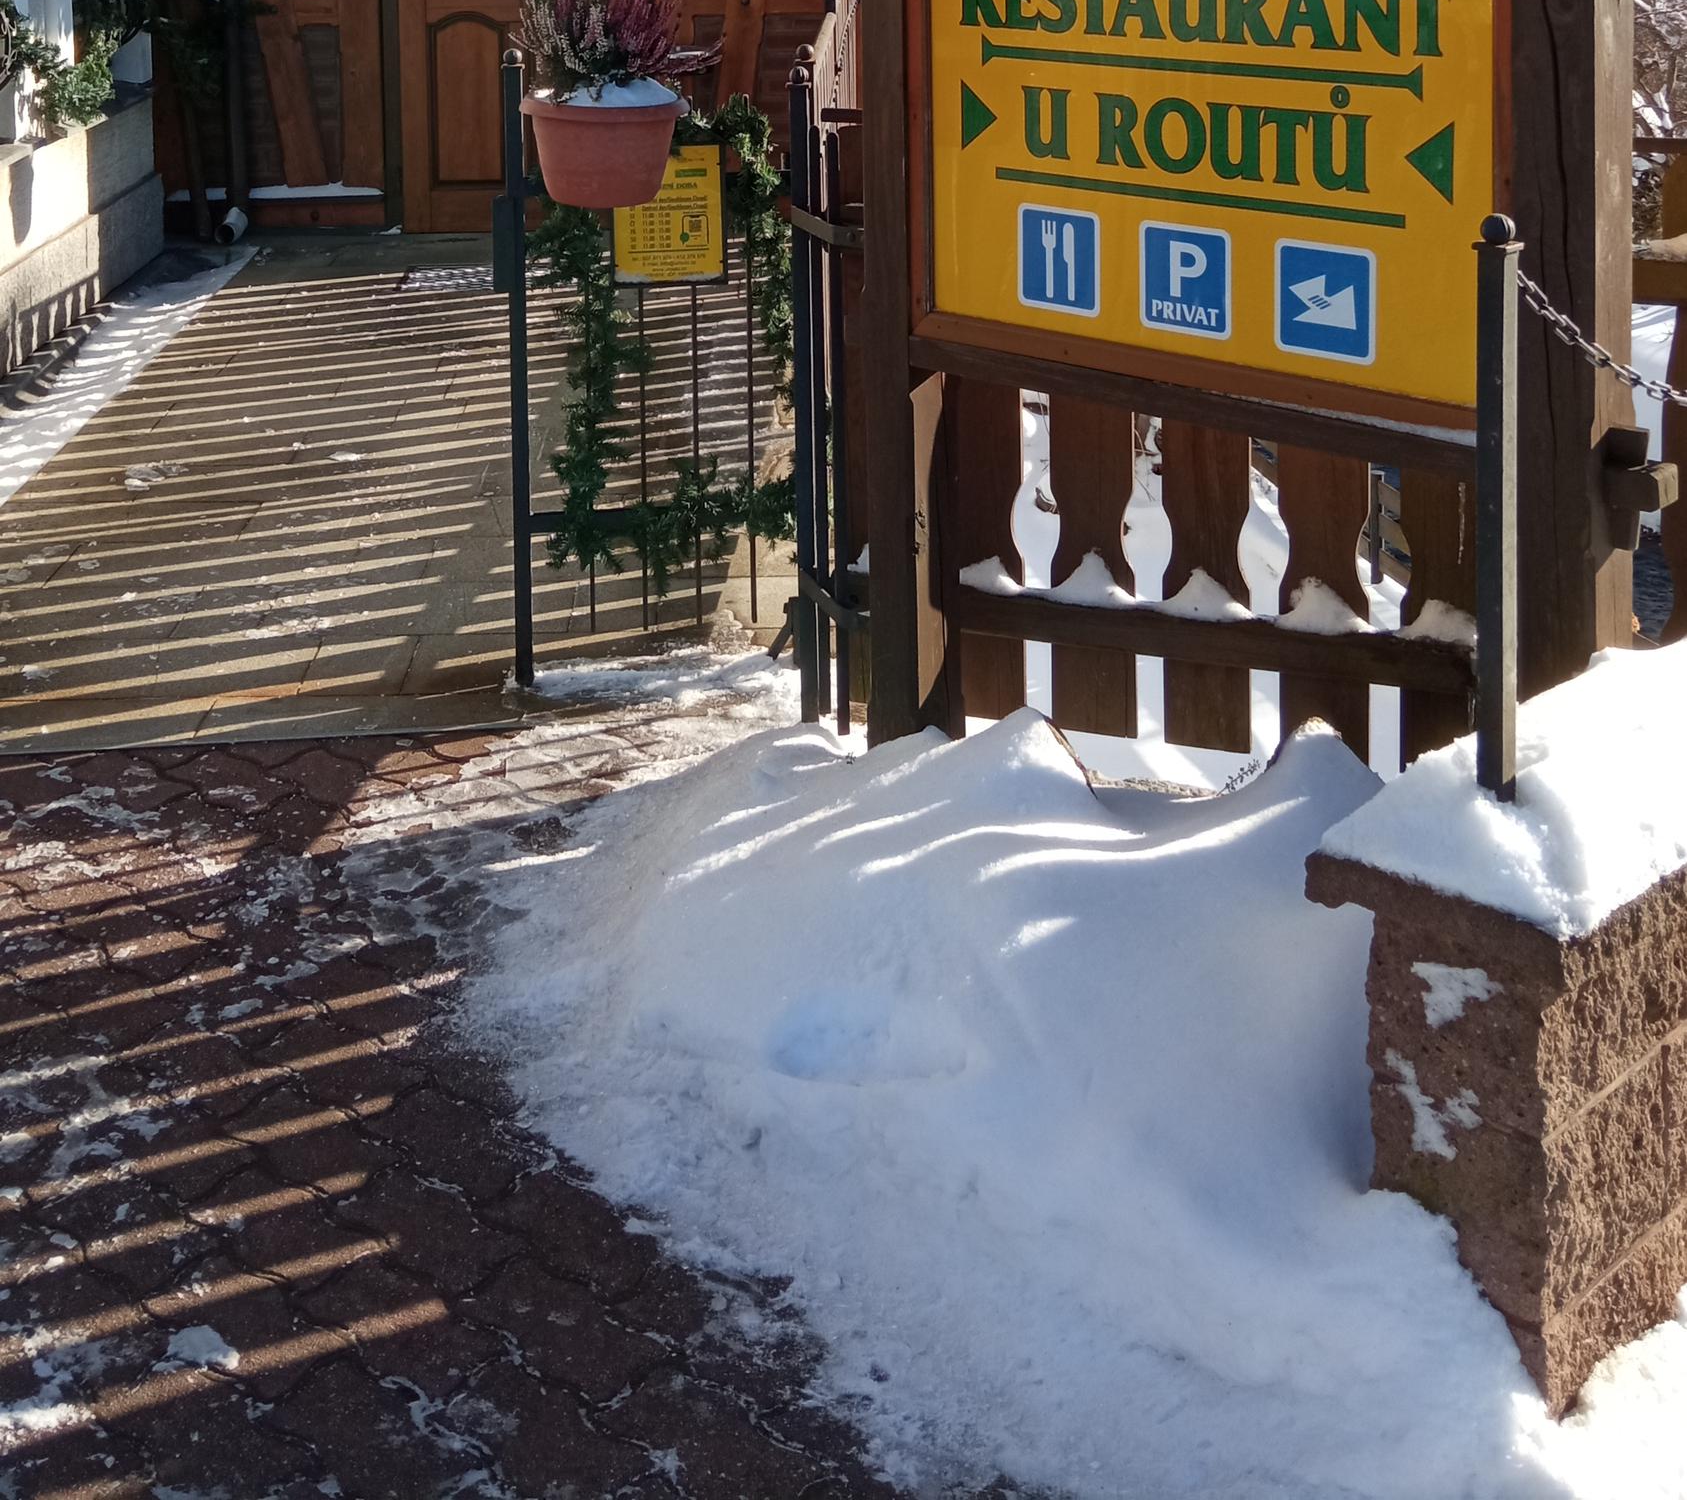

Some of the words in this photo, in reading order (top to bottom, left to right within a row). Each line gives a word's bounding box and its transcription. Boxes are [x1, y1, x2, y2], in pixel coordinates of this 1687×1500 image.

[1022, 85, 1071, 160] U
[1094, 84, 1371, 194] ROUTŮ
[1169, 240, 1207, 297] P
[1151, 299, 1219, 328] PRIVAT
